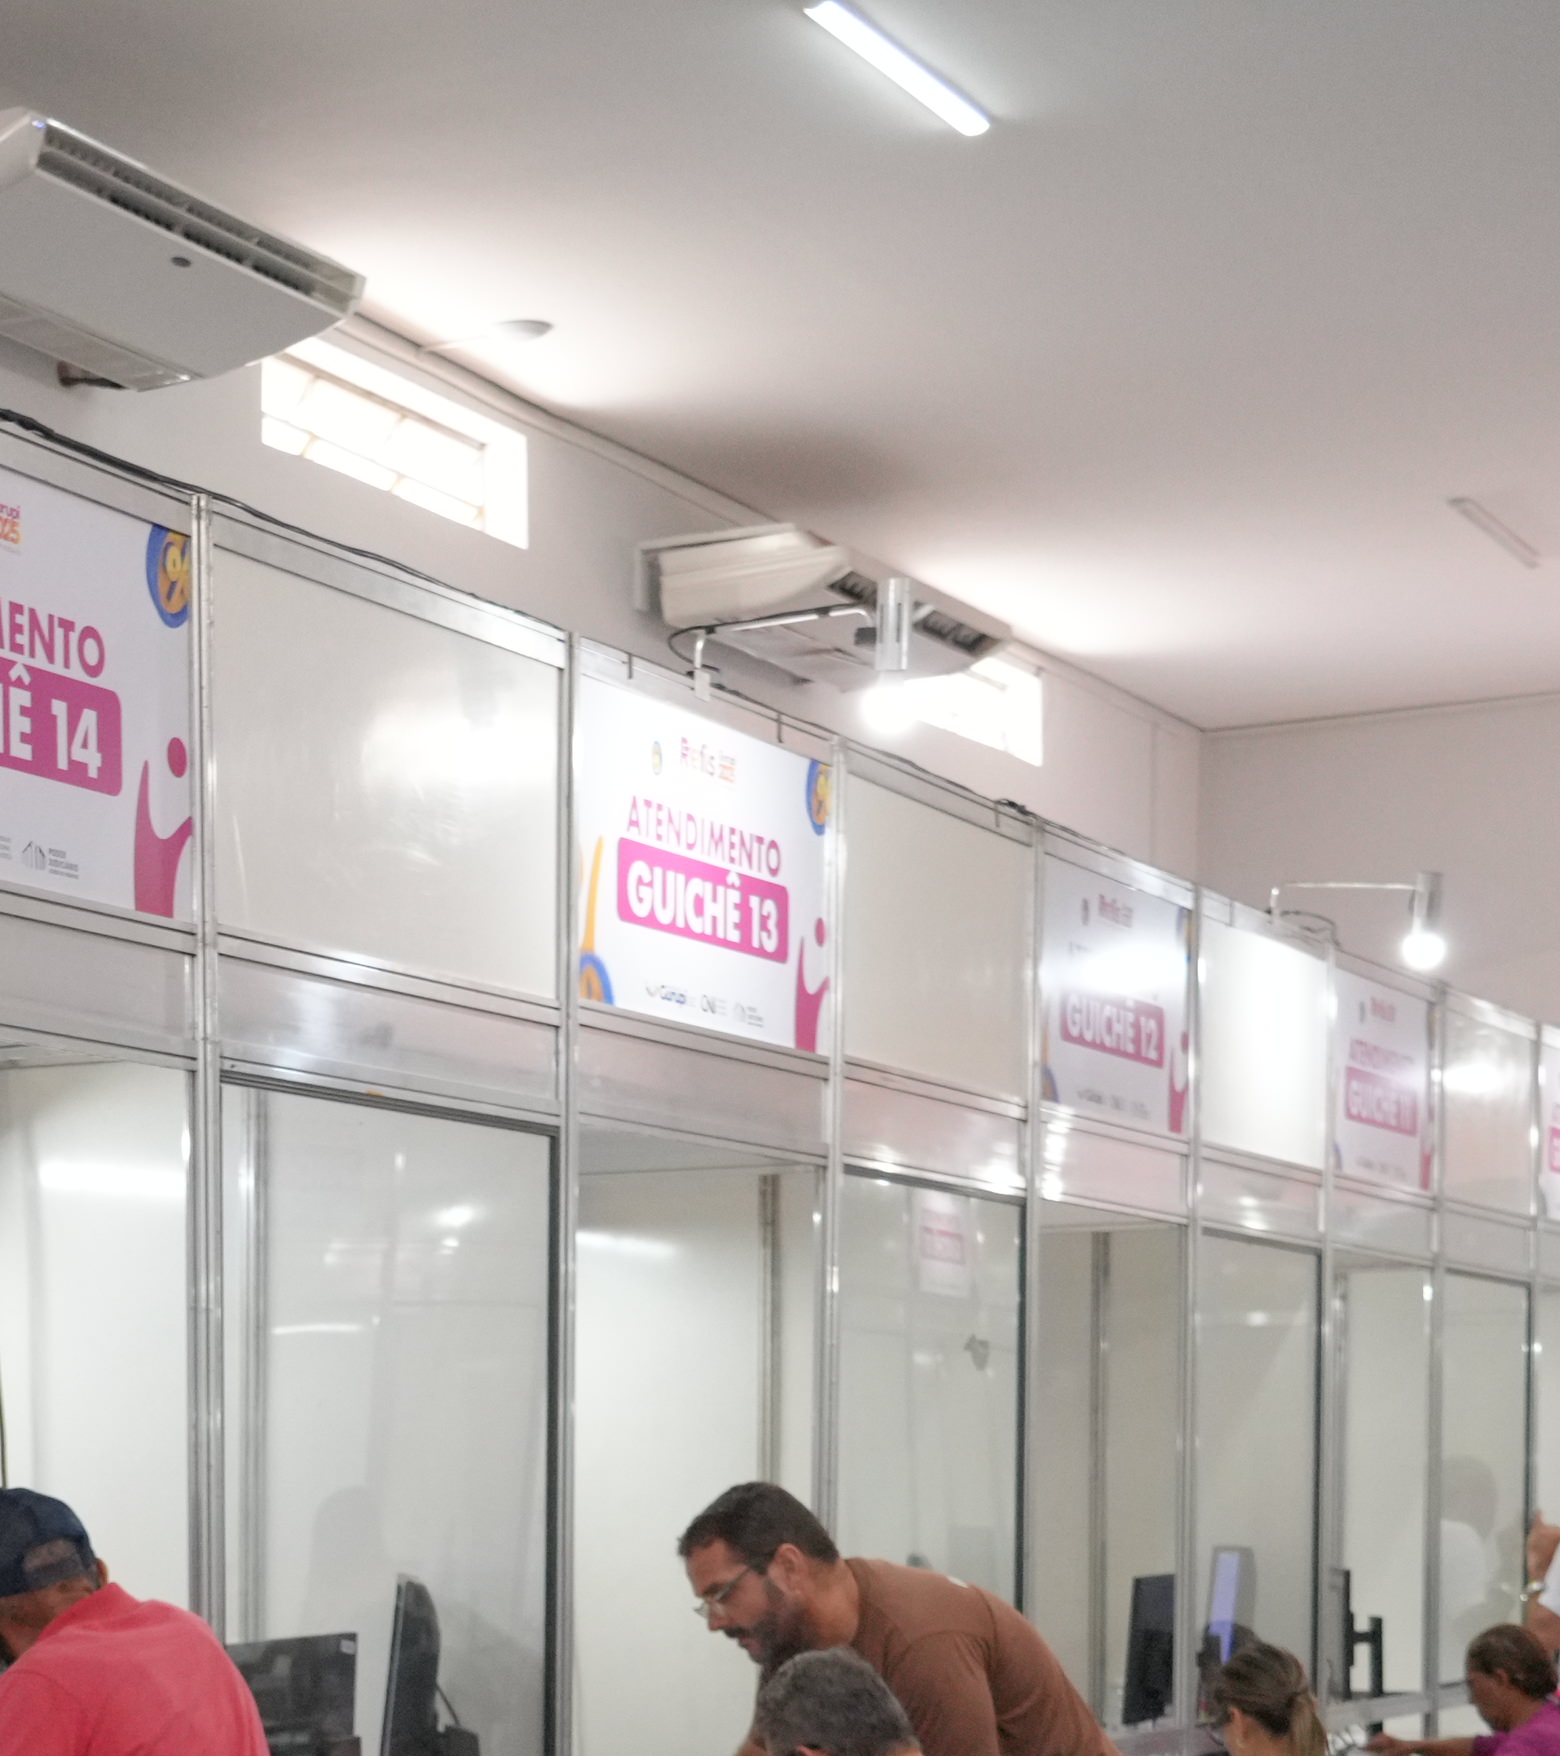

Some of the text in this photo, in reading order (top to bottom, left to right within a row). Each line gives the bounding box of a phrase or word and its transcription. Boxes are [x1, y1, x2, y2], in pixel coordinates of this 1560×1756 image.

[51, 699, 102, 779] 14
[626, 795, 781, 878] ATENDIMENTO
[626, 859, 778, 954] GUICHÊ 13
[1139, 1016, 1159, 1061] 12
